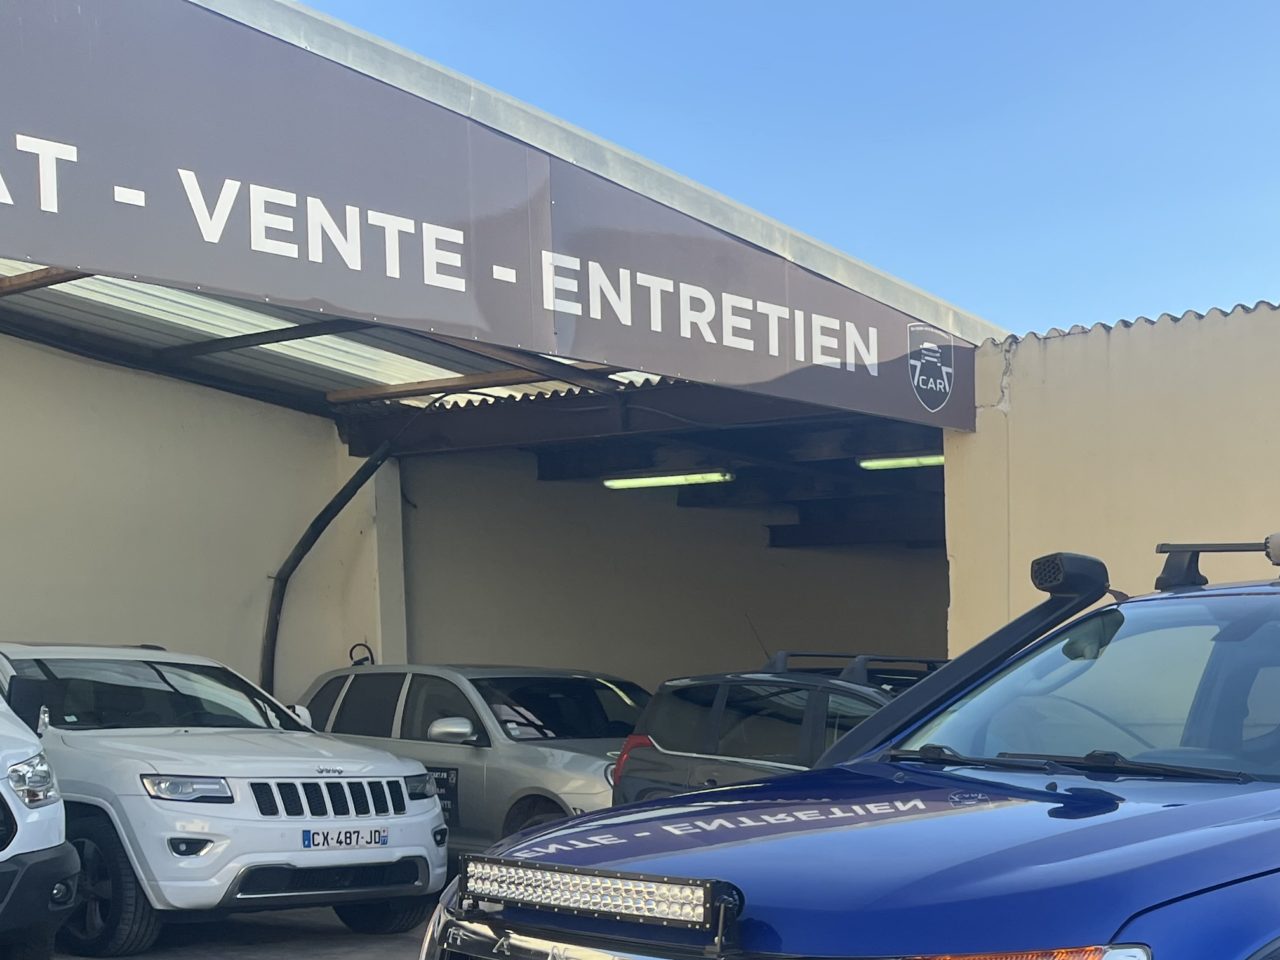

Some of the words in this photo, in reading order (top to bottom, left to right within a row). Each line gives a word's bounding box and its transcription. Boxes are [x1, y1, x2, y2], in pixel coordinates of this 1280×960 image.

[178, 168, 466, 292] VENTE
[541, 250, 878, 377] ENTRETIEN
[311, 829, 381, 847] CX-487-JD
